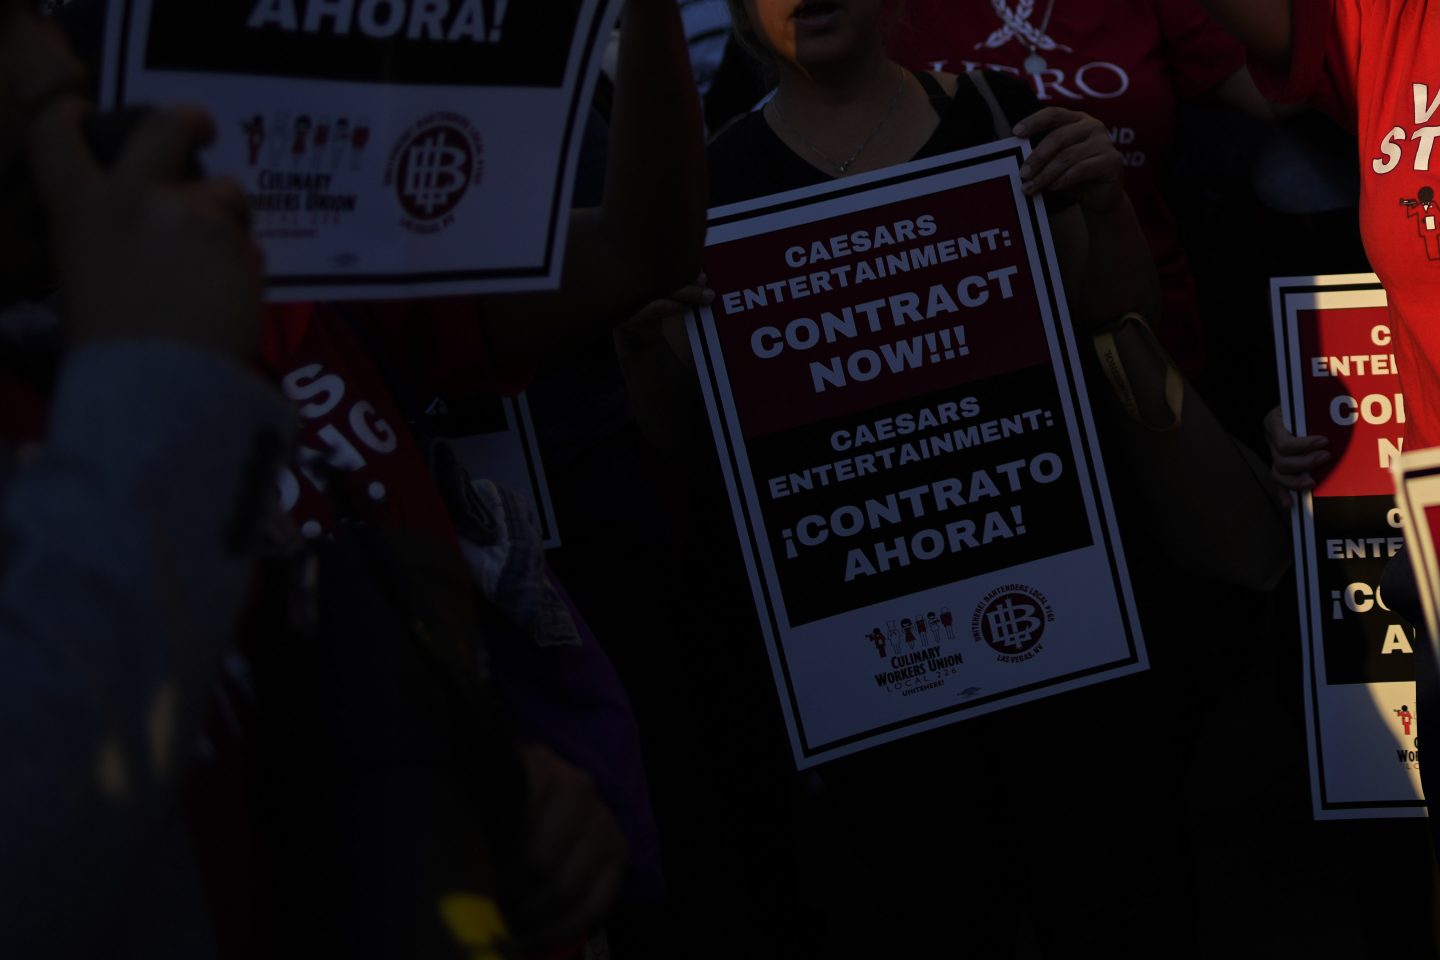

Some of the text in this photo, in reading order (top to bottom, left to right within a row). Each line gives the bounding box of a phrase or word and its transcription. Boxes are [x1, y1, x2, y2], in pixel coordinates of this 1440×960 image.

[928, 60, 1131, 100] RO
[783, 212, 939, 271] CAESARS
[721, 226, 1012, 318] ENTERTAINMENT:
[749, 265, 1020, 361] CONTRACT
[808, 324, 971, 395] NOW!!!
[767, 406, 1056, 500] ENTERTAINMENT:
[828, 395, 982, 454] CAESARS
[779, 451, 1065, 560] ¡CONTRATO
[842, 503, 1028, 585] AHORA!
[983, 583, 1028, 603] BARTENDERS
[1028, 586, 1049, 606] LOCAL
[874, 652, 964, 687] WORKERS UNION
[886, 668, 957, 693] LOCAL 226
[891, 646, 941, 670] CULINARY
